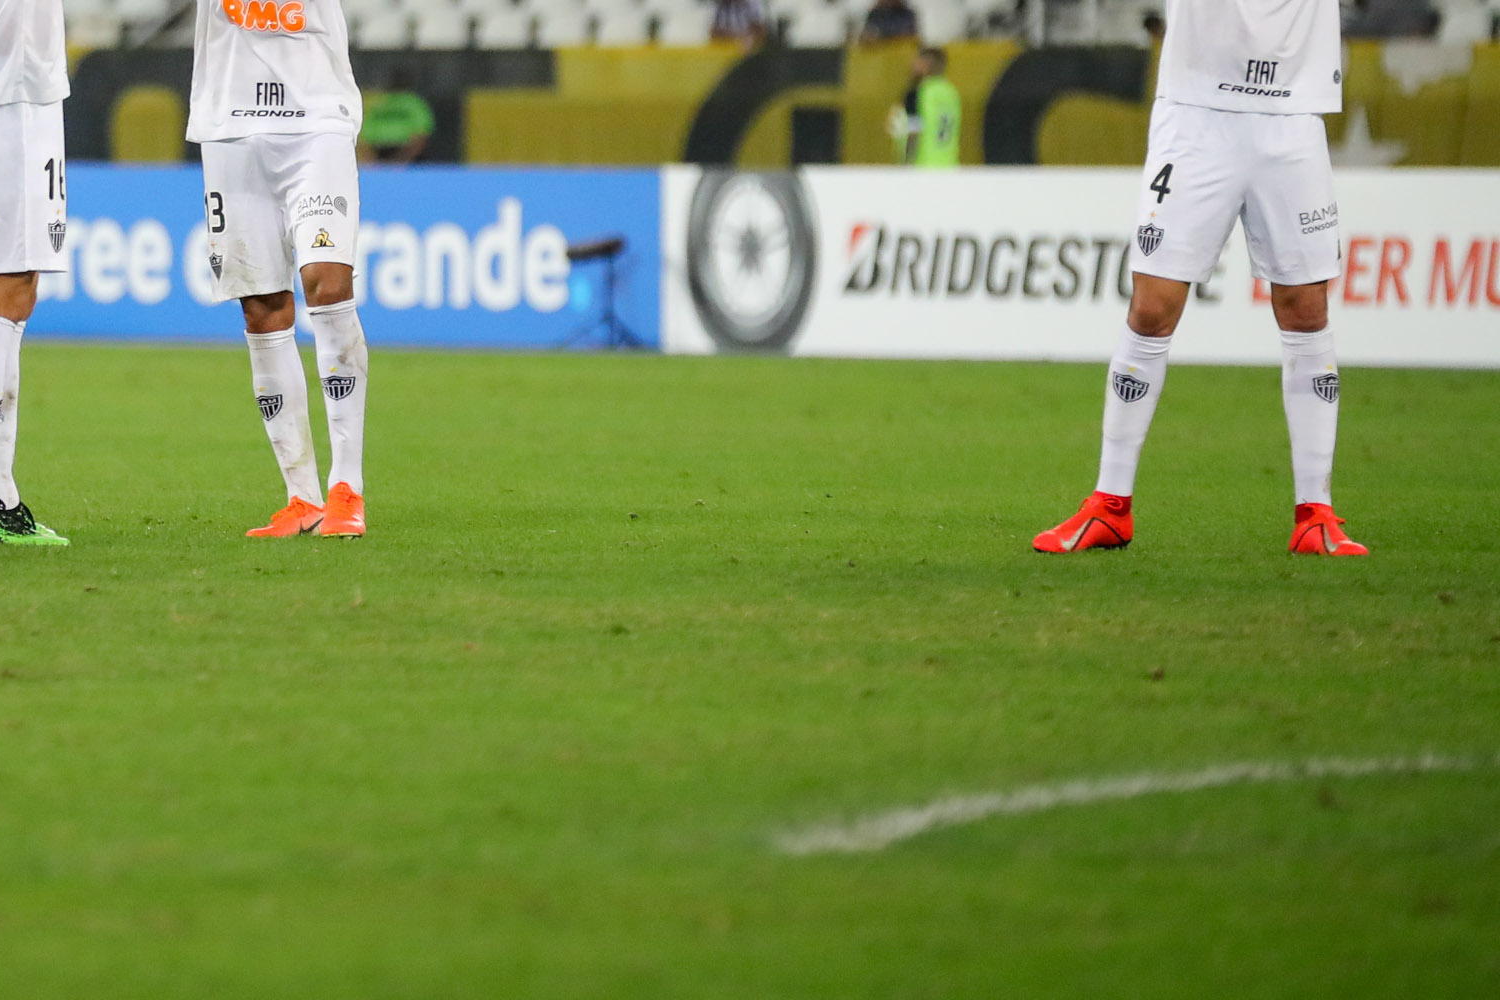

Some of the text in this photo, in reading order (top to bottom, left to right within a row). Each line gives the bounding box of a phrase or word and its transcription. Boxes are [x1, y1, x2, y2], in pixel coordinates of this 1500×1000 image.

[1245, 60, 1278, 85] FIAT
[256, 82, 285, 106] FIAT
[1218, 82, 1291, 98] CRONOS
[230, 109, 306, 118] CRONOS
[1150, 163, 1174, 204] 4
[353, 197, 572, 313] rande
[1115, 376, 1145, 389] CAM
